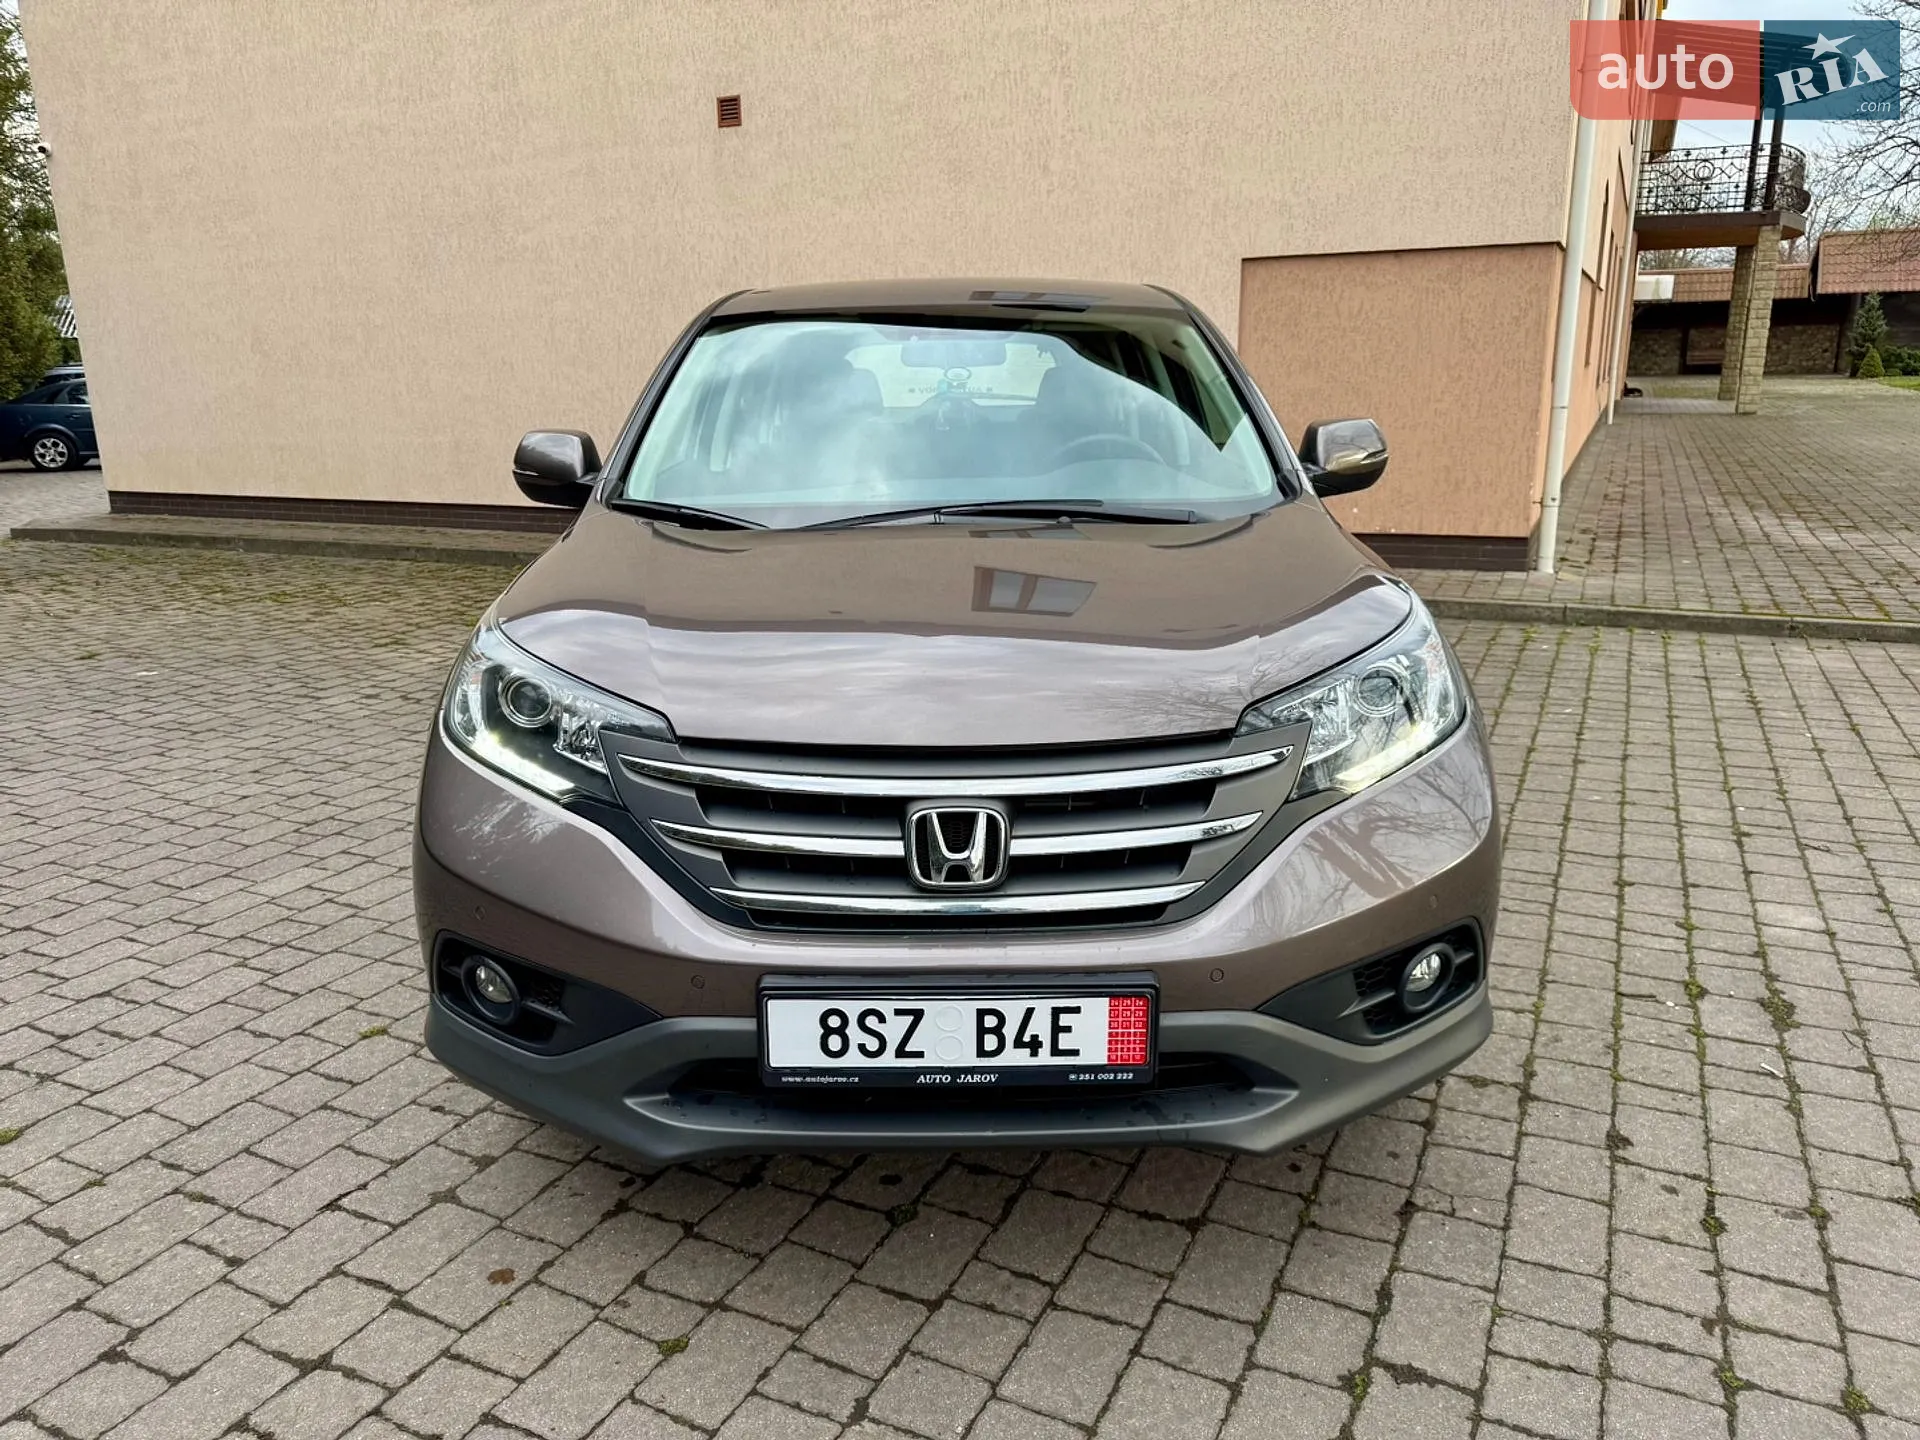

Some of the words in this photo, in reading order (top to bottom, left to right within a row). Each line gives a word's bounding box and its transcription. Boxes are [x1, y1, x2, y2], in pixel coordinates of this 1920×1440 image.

[818, 1006, 926, 1059] 8SZ
[975, 1005, 1082, 1059] B4E
[916, 1074, 951, 1083] AUTO
[956, 1073, 999, 1083] JAROV
